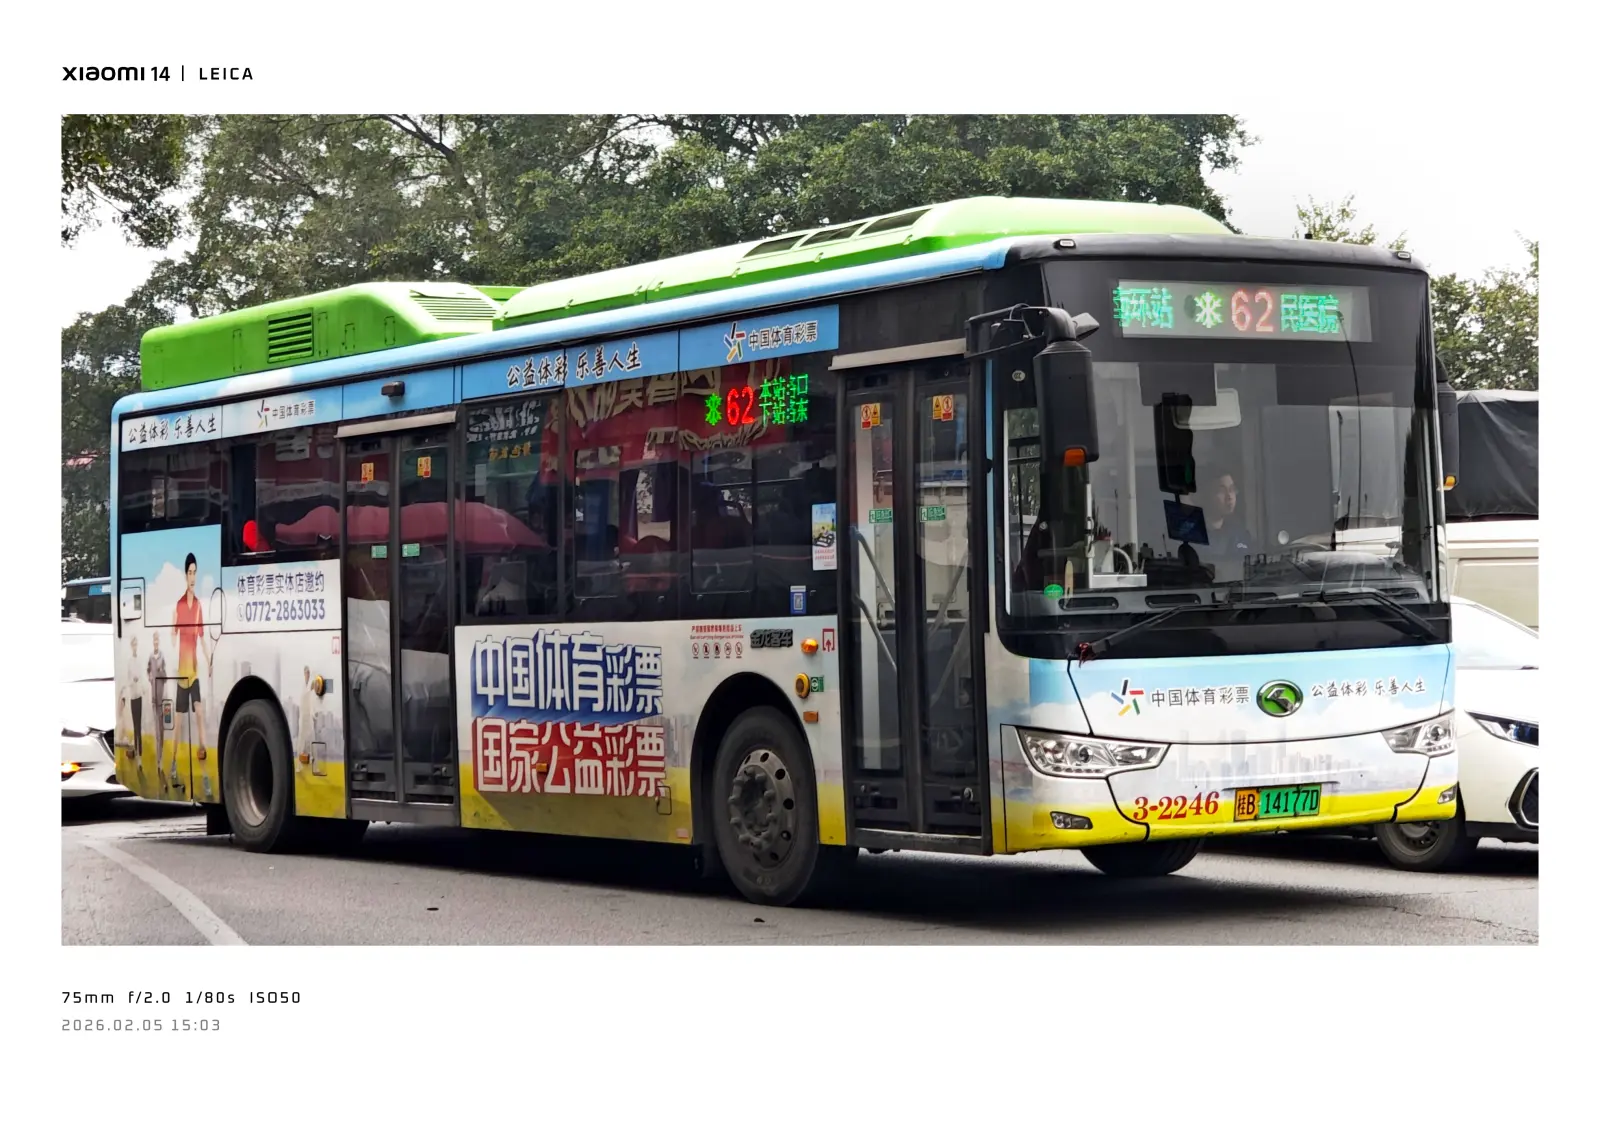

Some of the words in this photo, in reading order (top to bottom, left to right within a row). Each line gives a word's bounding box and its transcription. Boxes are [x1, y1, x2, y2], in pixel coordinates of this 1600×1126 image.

[1231, 290, 1274, 332] 62
[748, 320, 818, 349] 中国体育彩票
[506, 354, 568, 388] 公益体彩
[575, 341, 642, 379] 乐善人生
[727, 386, 755, 425] 62
[128, 418, 169, 444] 公益体彩
[173, 412, 217, 440] 乐善人生
[237, 570, 326, 596] 体育彩票实体店邀约
[245, 598, 326, 622] 0772-2863033
[473, 628, 664, 715] 中国体育彩票
[1151, 685, 1250, 708] 中国体育彩票
[1311, 682, 1368, 698] 公益体彩
[1374, 677, 1427, 695] 乐善人生
[473, 717, 667, 798] 国家公益彩票
[1133, 791, 1221, 822] 3-2246
